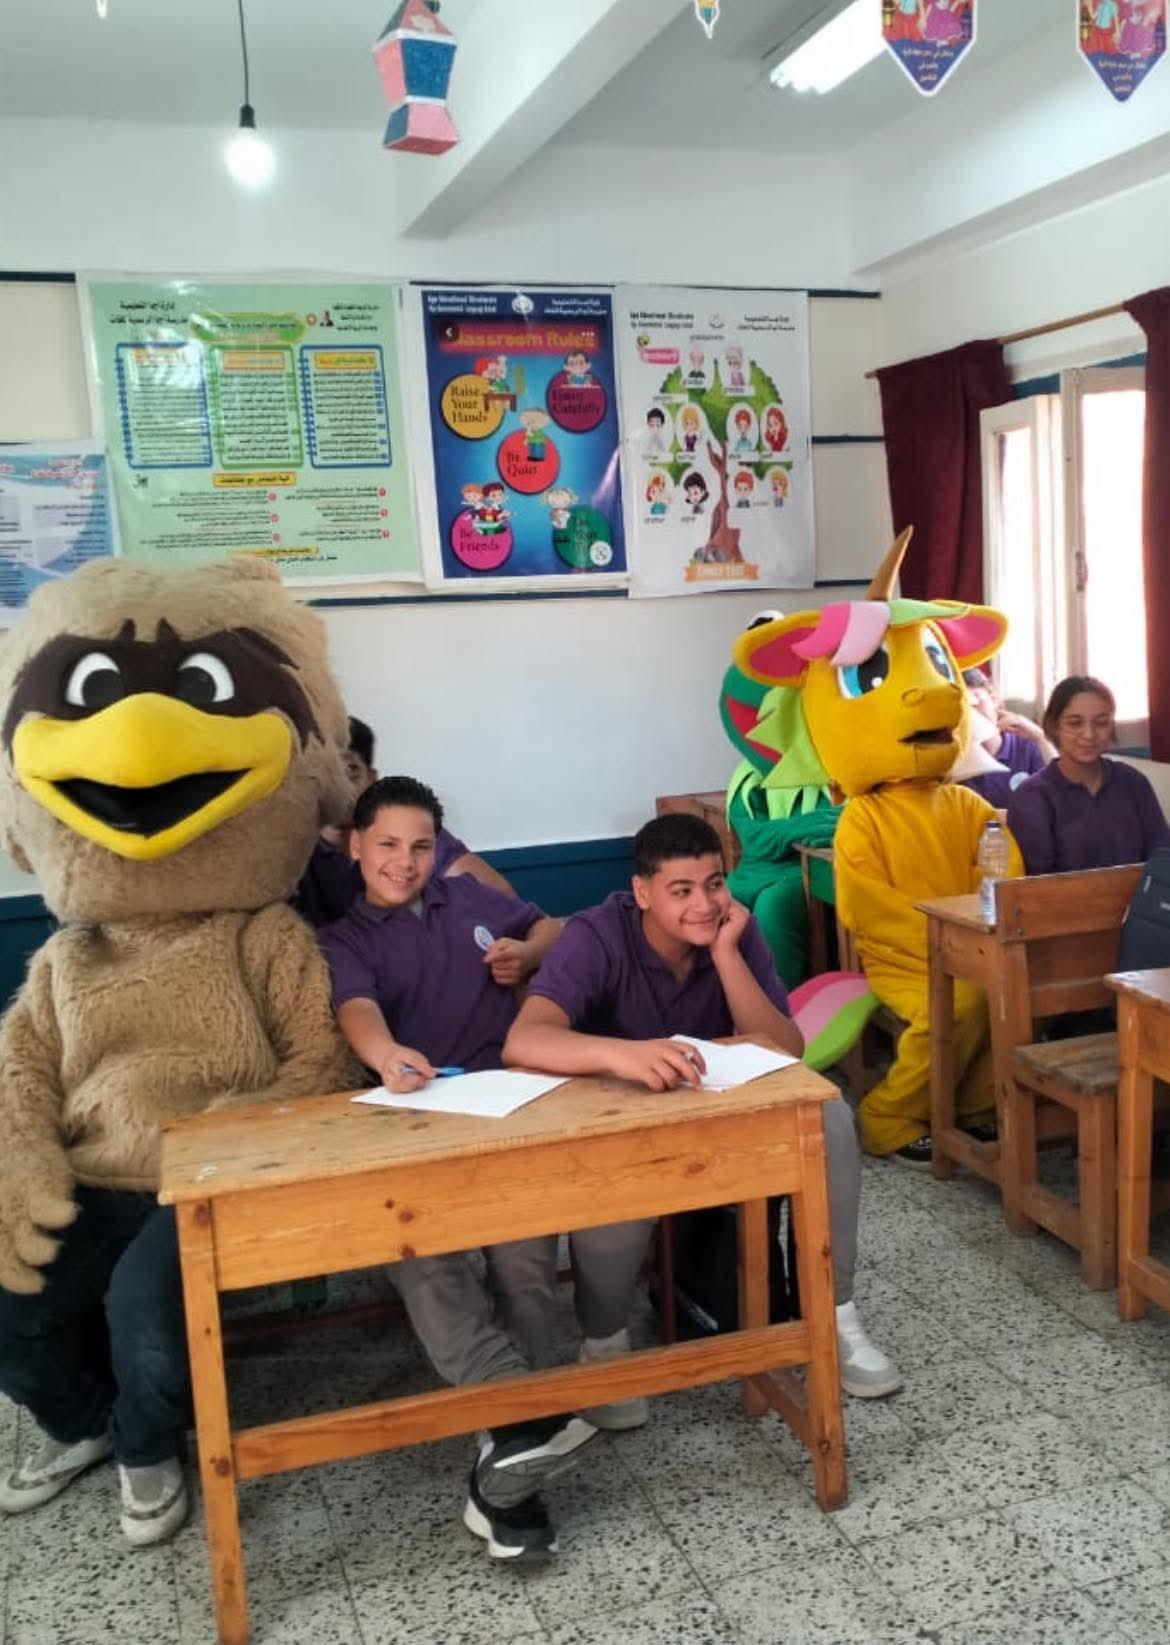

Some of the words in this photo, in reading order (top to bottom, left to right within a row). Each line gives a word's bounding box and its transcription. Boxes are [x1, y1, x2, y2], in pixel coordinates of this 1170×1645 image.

[451, 384, 482, 397] Raise
[450, 398, 478, 410] Your
[452, 410, 488, 424] Hands
